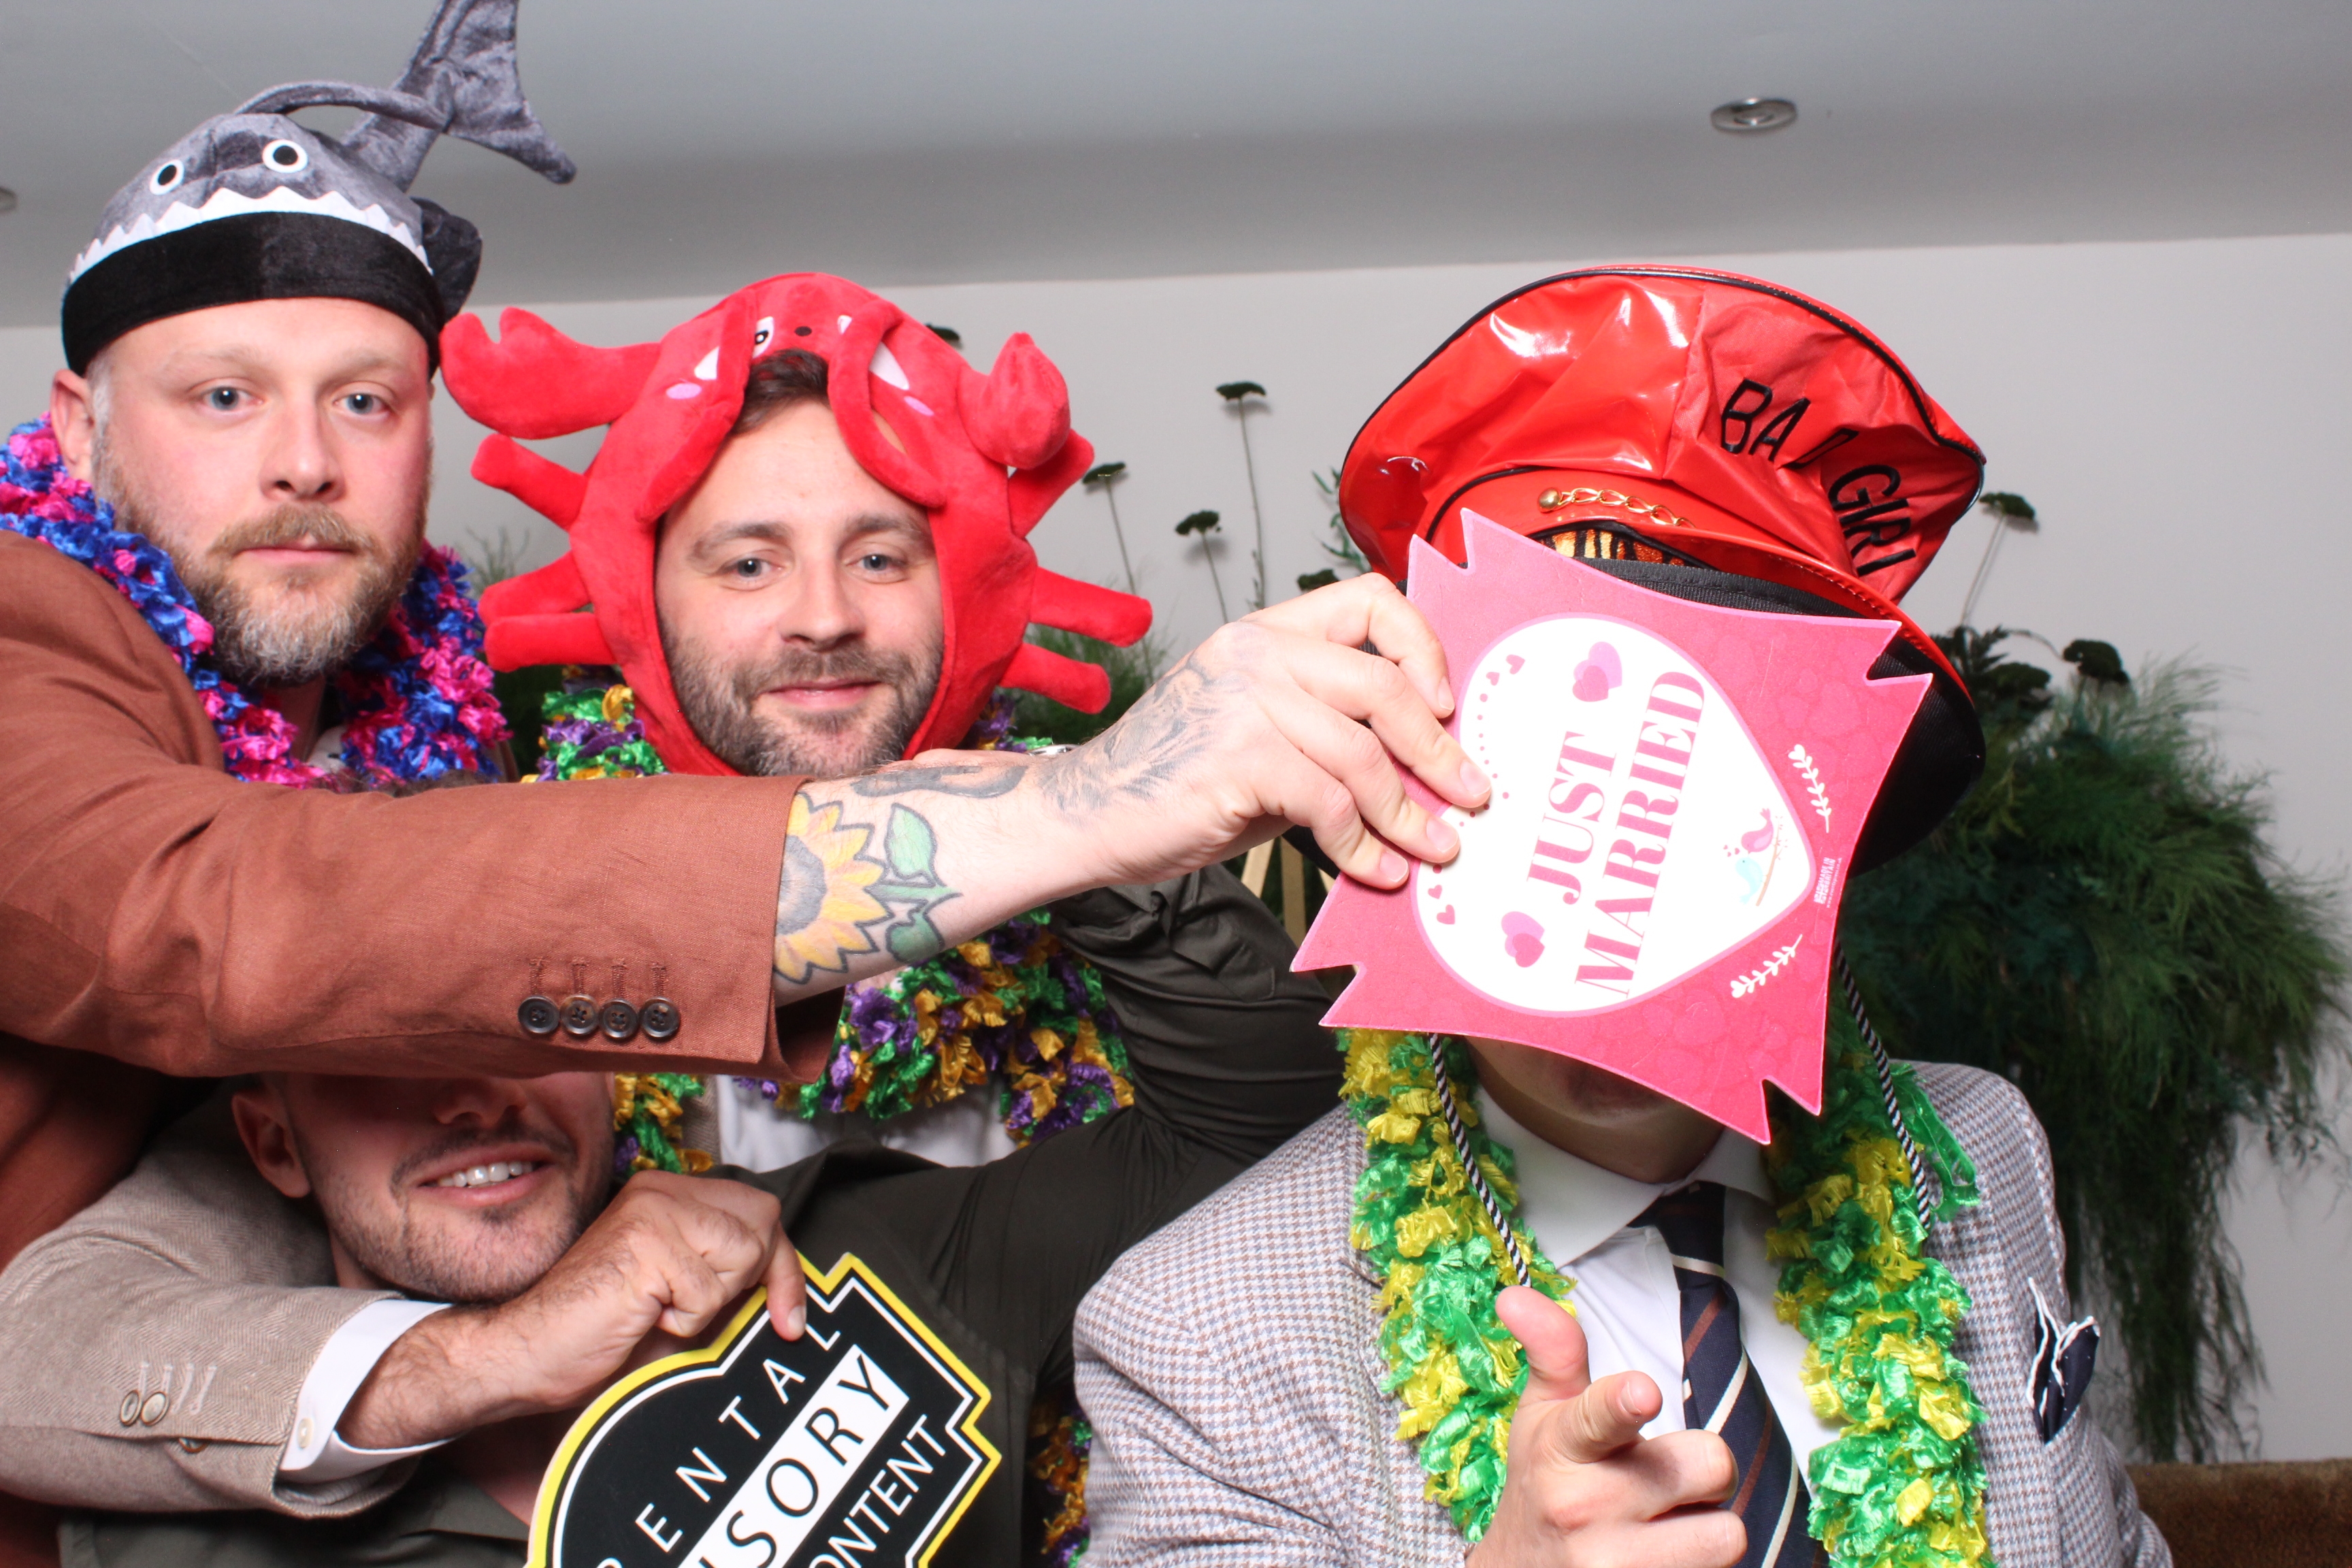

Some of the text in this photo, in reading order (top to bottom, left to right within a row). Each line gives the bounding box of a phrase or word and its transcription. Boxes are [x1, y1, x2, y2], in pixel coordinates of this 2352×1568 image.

[1526, 731, 1616, 905] JUST
[1574, 672, 1704, 998] MARRIED
[1817, 864, 1829, 883] MADE
[1823, 858, 1835, 885] BRITAIN
[596, 1323, 841, 1568] ENTAL
[699, 1354, 890, 1568] SORY
